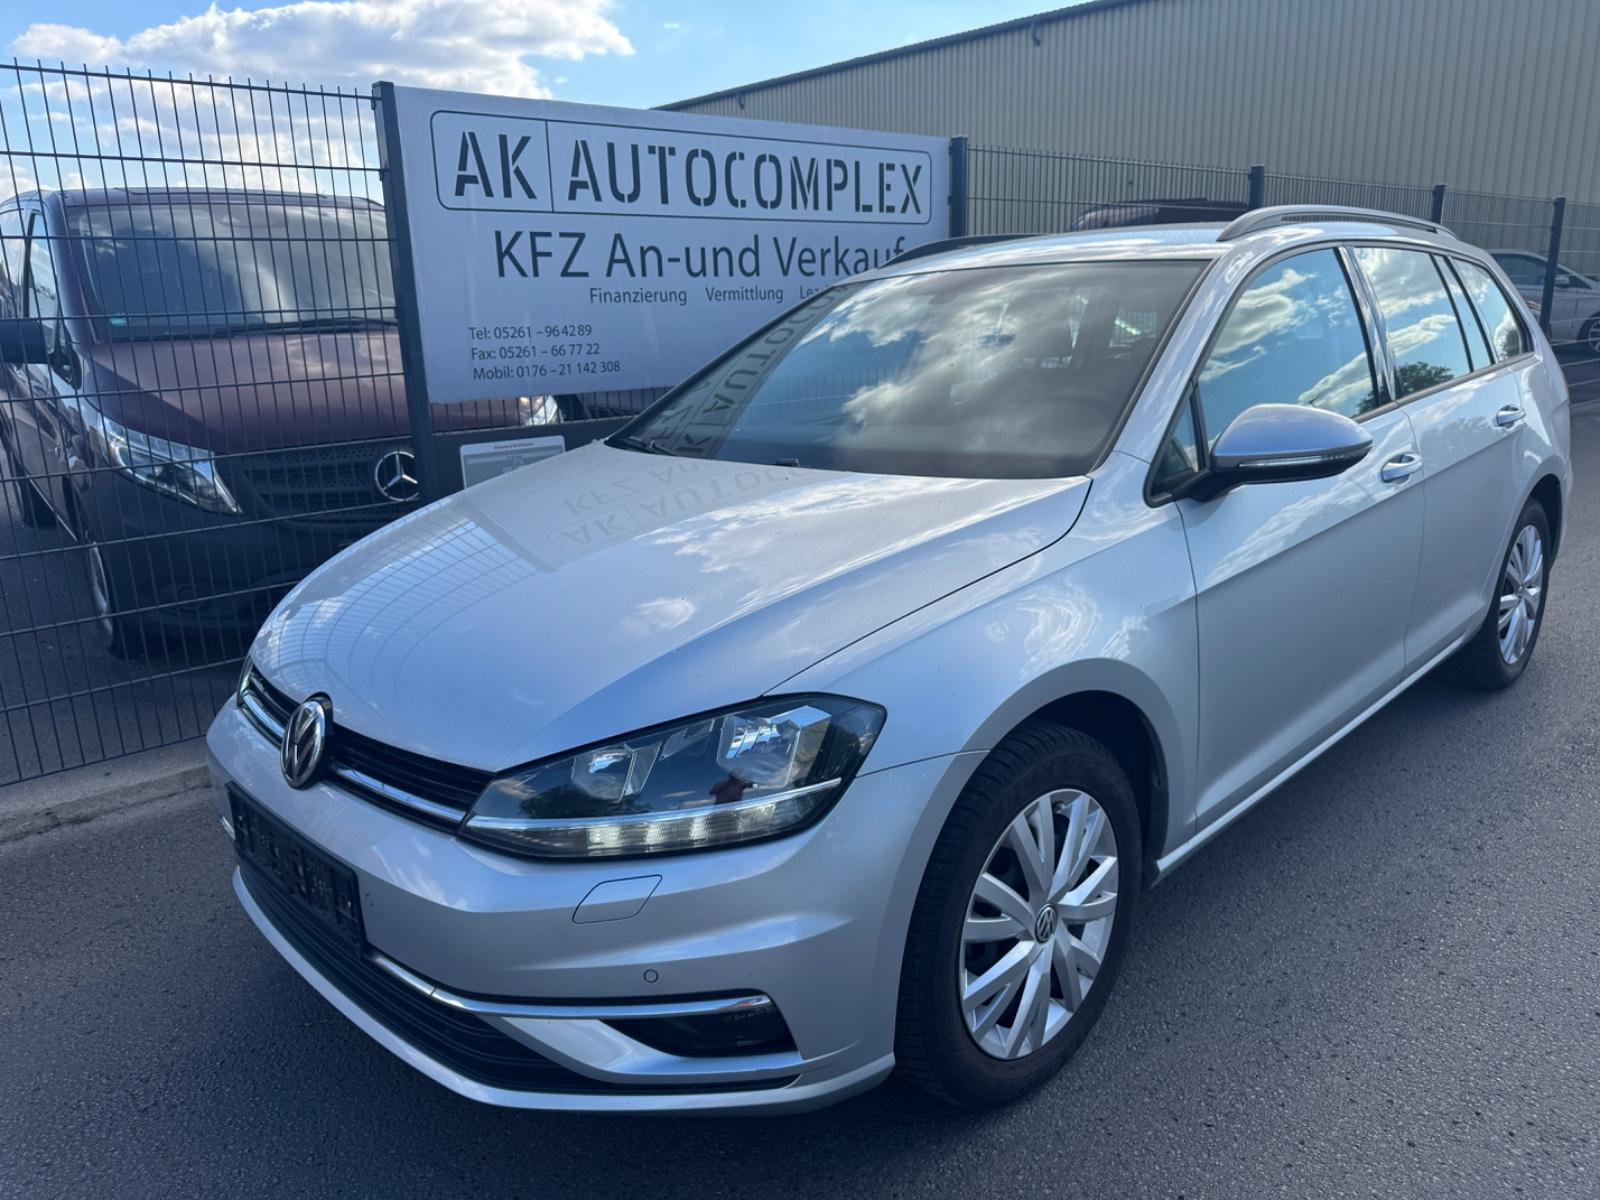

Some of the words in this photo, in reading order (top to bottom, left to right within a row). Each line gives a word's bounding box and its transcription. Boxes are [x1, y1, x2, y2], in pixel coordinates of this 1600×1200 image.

[454, 130, 537, 199] AK
[567, 139, 923, 215] AUTOCOMPLEX
[494, 230, 590, 278] KFZ
[605, 232, 761, 278] An-und
[589, 287, 688, 306] Finanzierung
[705, 286, 784, 304] Vermittlung
[468, 327, 491, 340] Tel:
[493, 326, 532, 340] 05261
[471, 347, 497, 361] Fax:
[499, 345, 537, 359] 05261
[473, 366, 514, 381] Mobil:
[516, 364, 548, 379] 0176
[600, 360, 621, 373] 308
